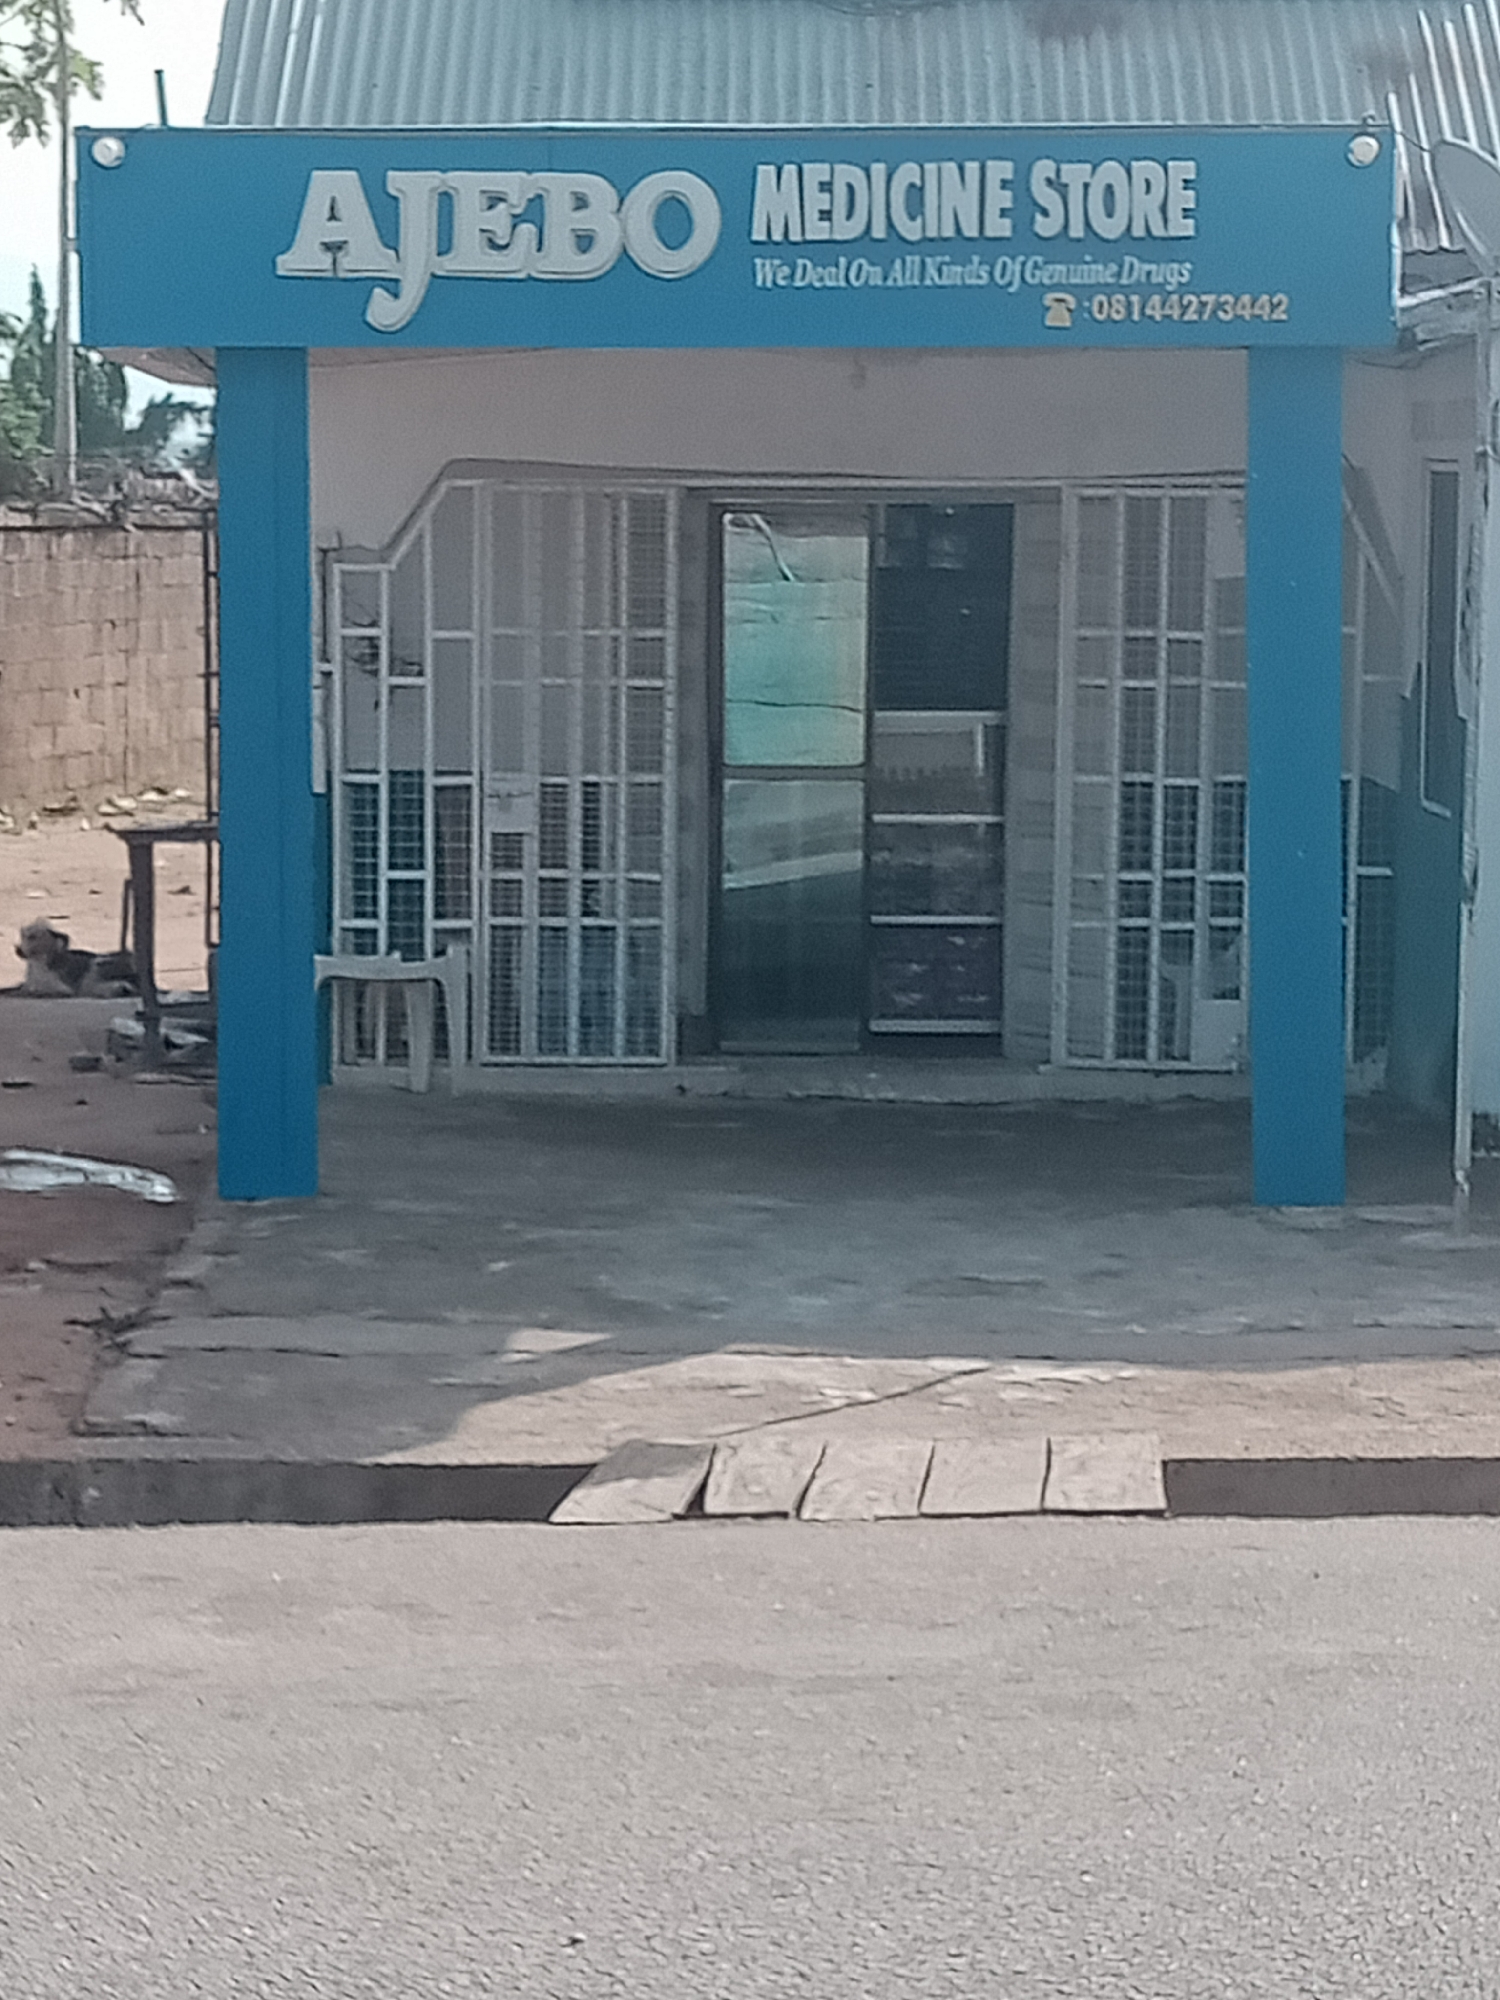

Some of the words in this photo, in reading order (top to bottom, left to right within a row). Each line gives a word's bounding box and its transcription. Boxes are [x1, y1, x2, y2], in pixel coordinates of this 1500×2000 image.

[750, 161, 1013, 243] MEDICINE
[1030, 158, 1198, 241] STORE
[275, 169, 722, 332] AJEBO
[753, 257, 791, 288] We
[792, 256, 848, 288] Deal
[848, 257, 883, 288] On
[885, 254, 922, 287] All
[923, 254, 990, 287] Kinds
[993, 255, 1026, 293] Of
[1023, 254, 1119, 286] Genuine
[1119, 254, 1193, 292] Drugs
